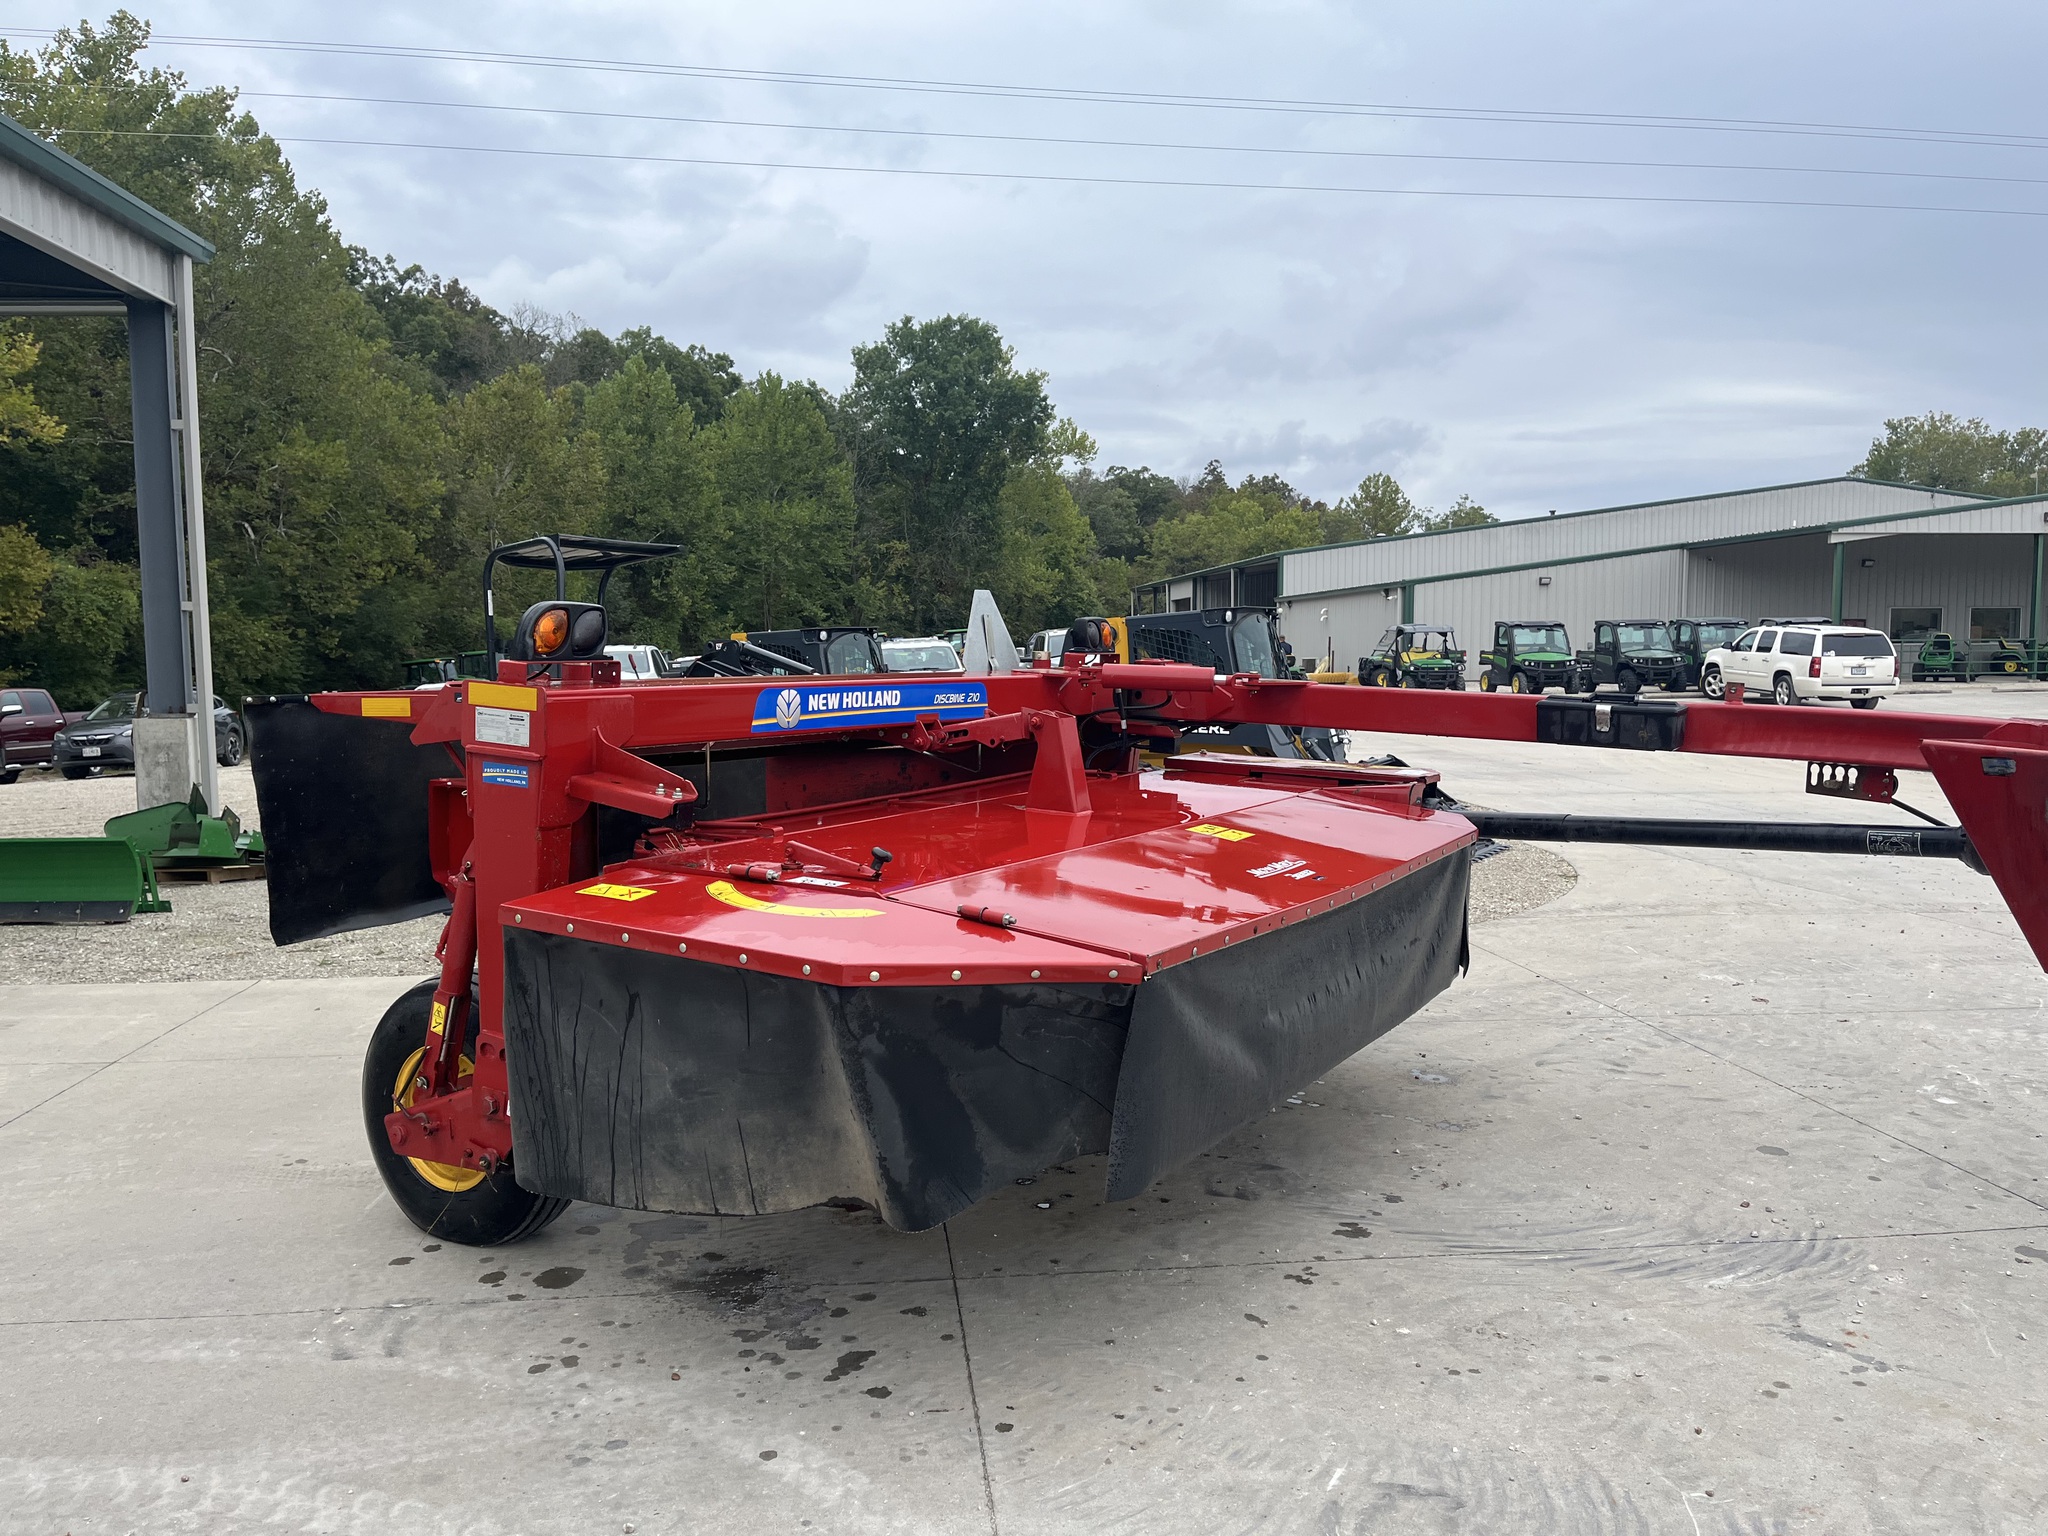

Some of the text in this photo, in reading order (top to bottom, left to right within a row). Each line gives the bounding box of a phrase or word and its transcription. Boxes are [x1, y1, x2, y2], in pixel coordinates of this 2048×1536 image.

[808, 690, 901, 711] NEW HOLLAND
[933, 693, 980, 704] DISCBINE 210
